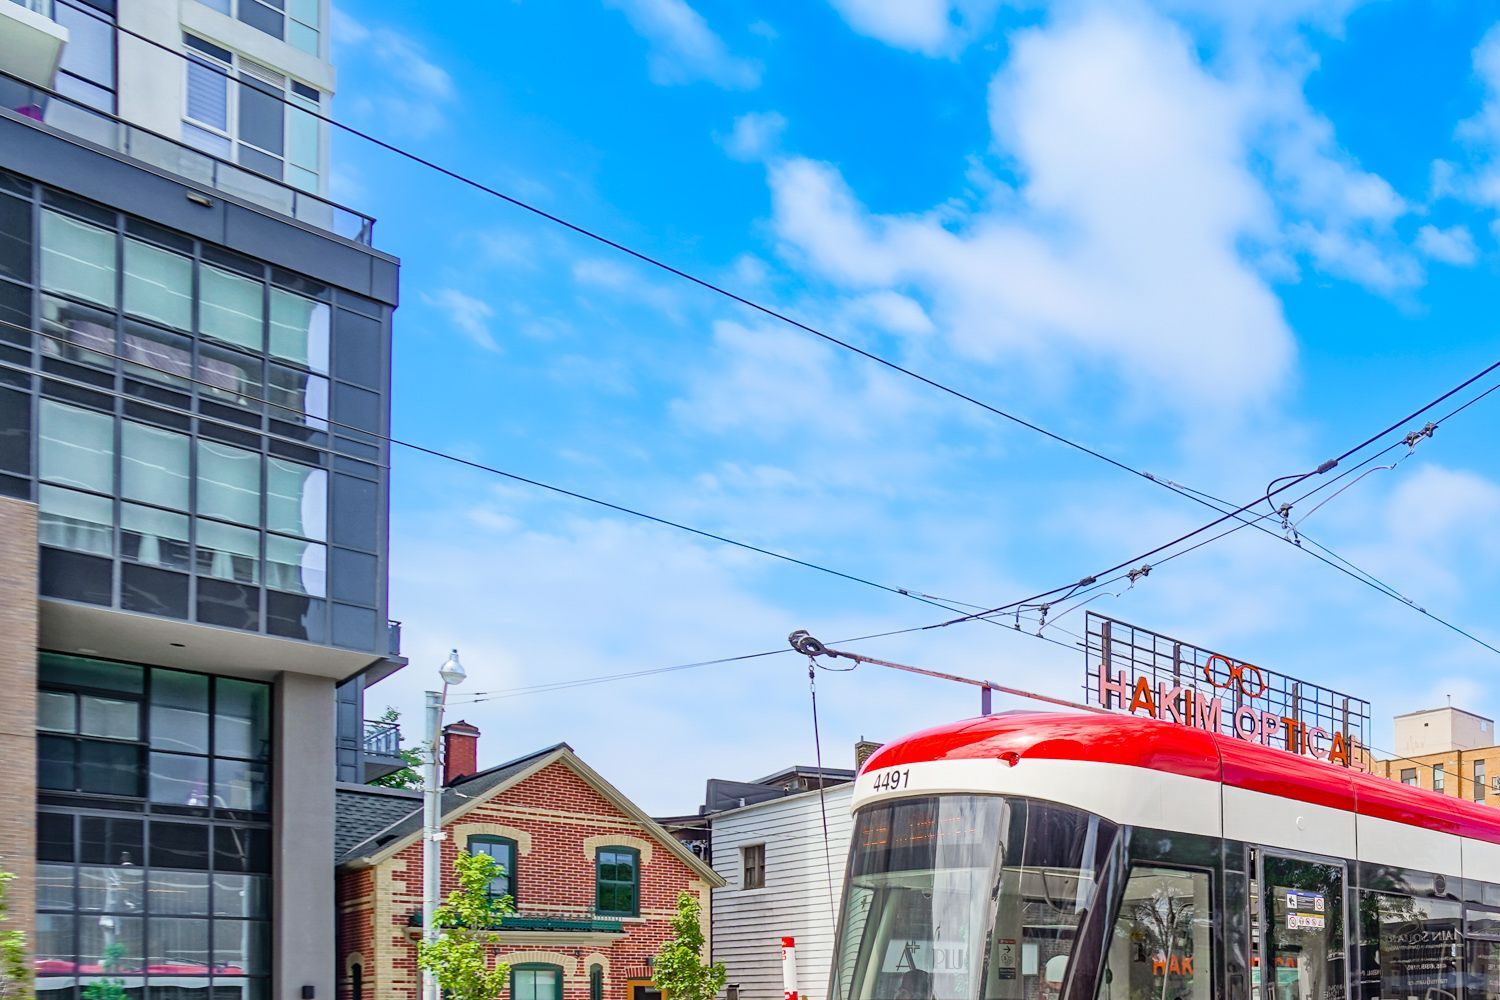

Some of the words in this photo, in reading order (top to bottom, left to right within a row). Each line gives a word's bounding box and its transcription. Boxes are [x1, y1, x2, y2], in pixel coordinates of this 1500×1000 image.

[1098, 664, 1222, 734] HAKIM
[1235, 705, 1366, 772] OPTICAL
[873, 769, 910, 792] 4491
[1153, 955, 1194, 975] HAK
